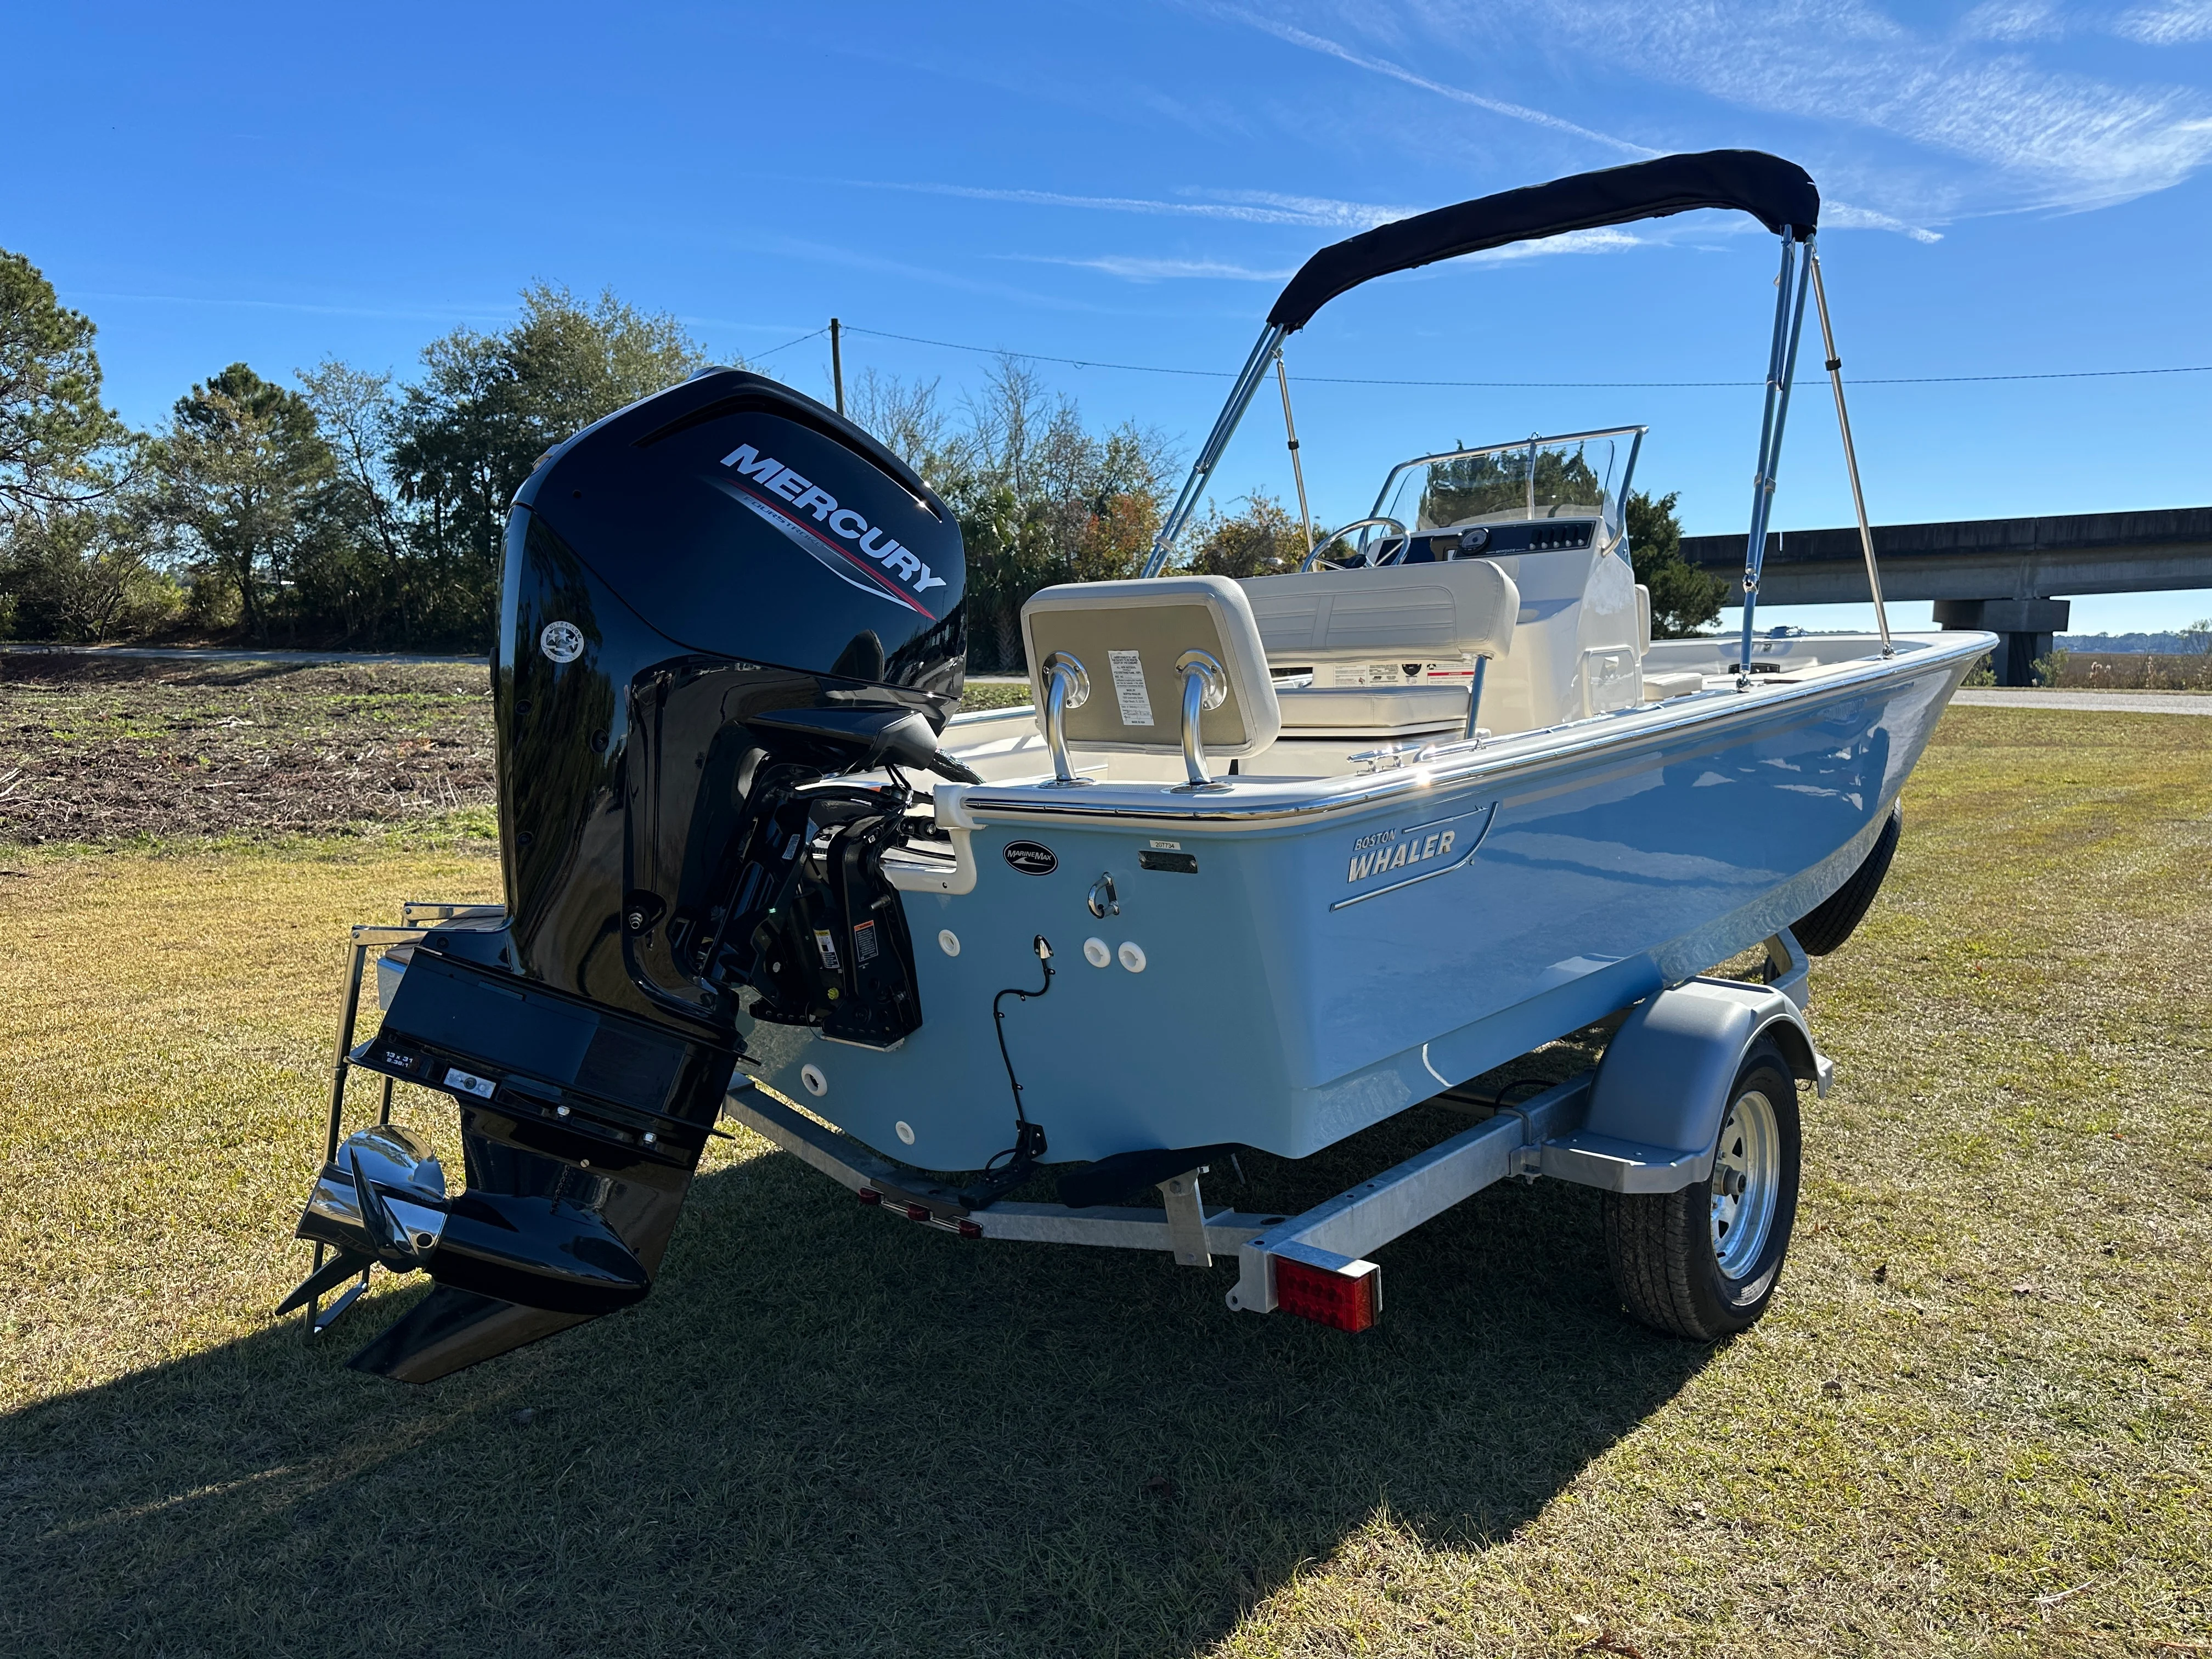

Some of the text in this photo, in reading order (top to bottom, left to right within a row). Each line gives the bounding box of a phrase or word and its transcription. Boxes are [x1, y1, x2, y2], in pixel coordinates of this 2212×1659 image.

[720, 443, 946, 593] MERCURY
[743, 495, 823, 548] FOURSTROKE
[1347, 829, 1455, 883] WHALER
[1353, 828, 1396, 851] BOSTON
